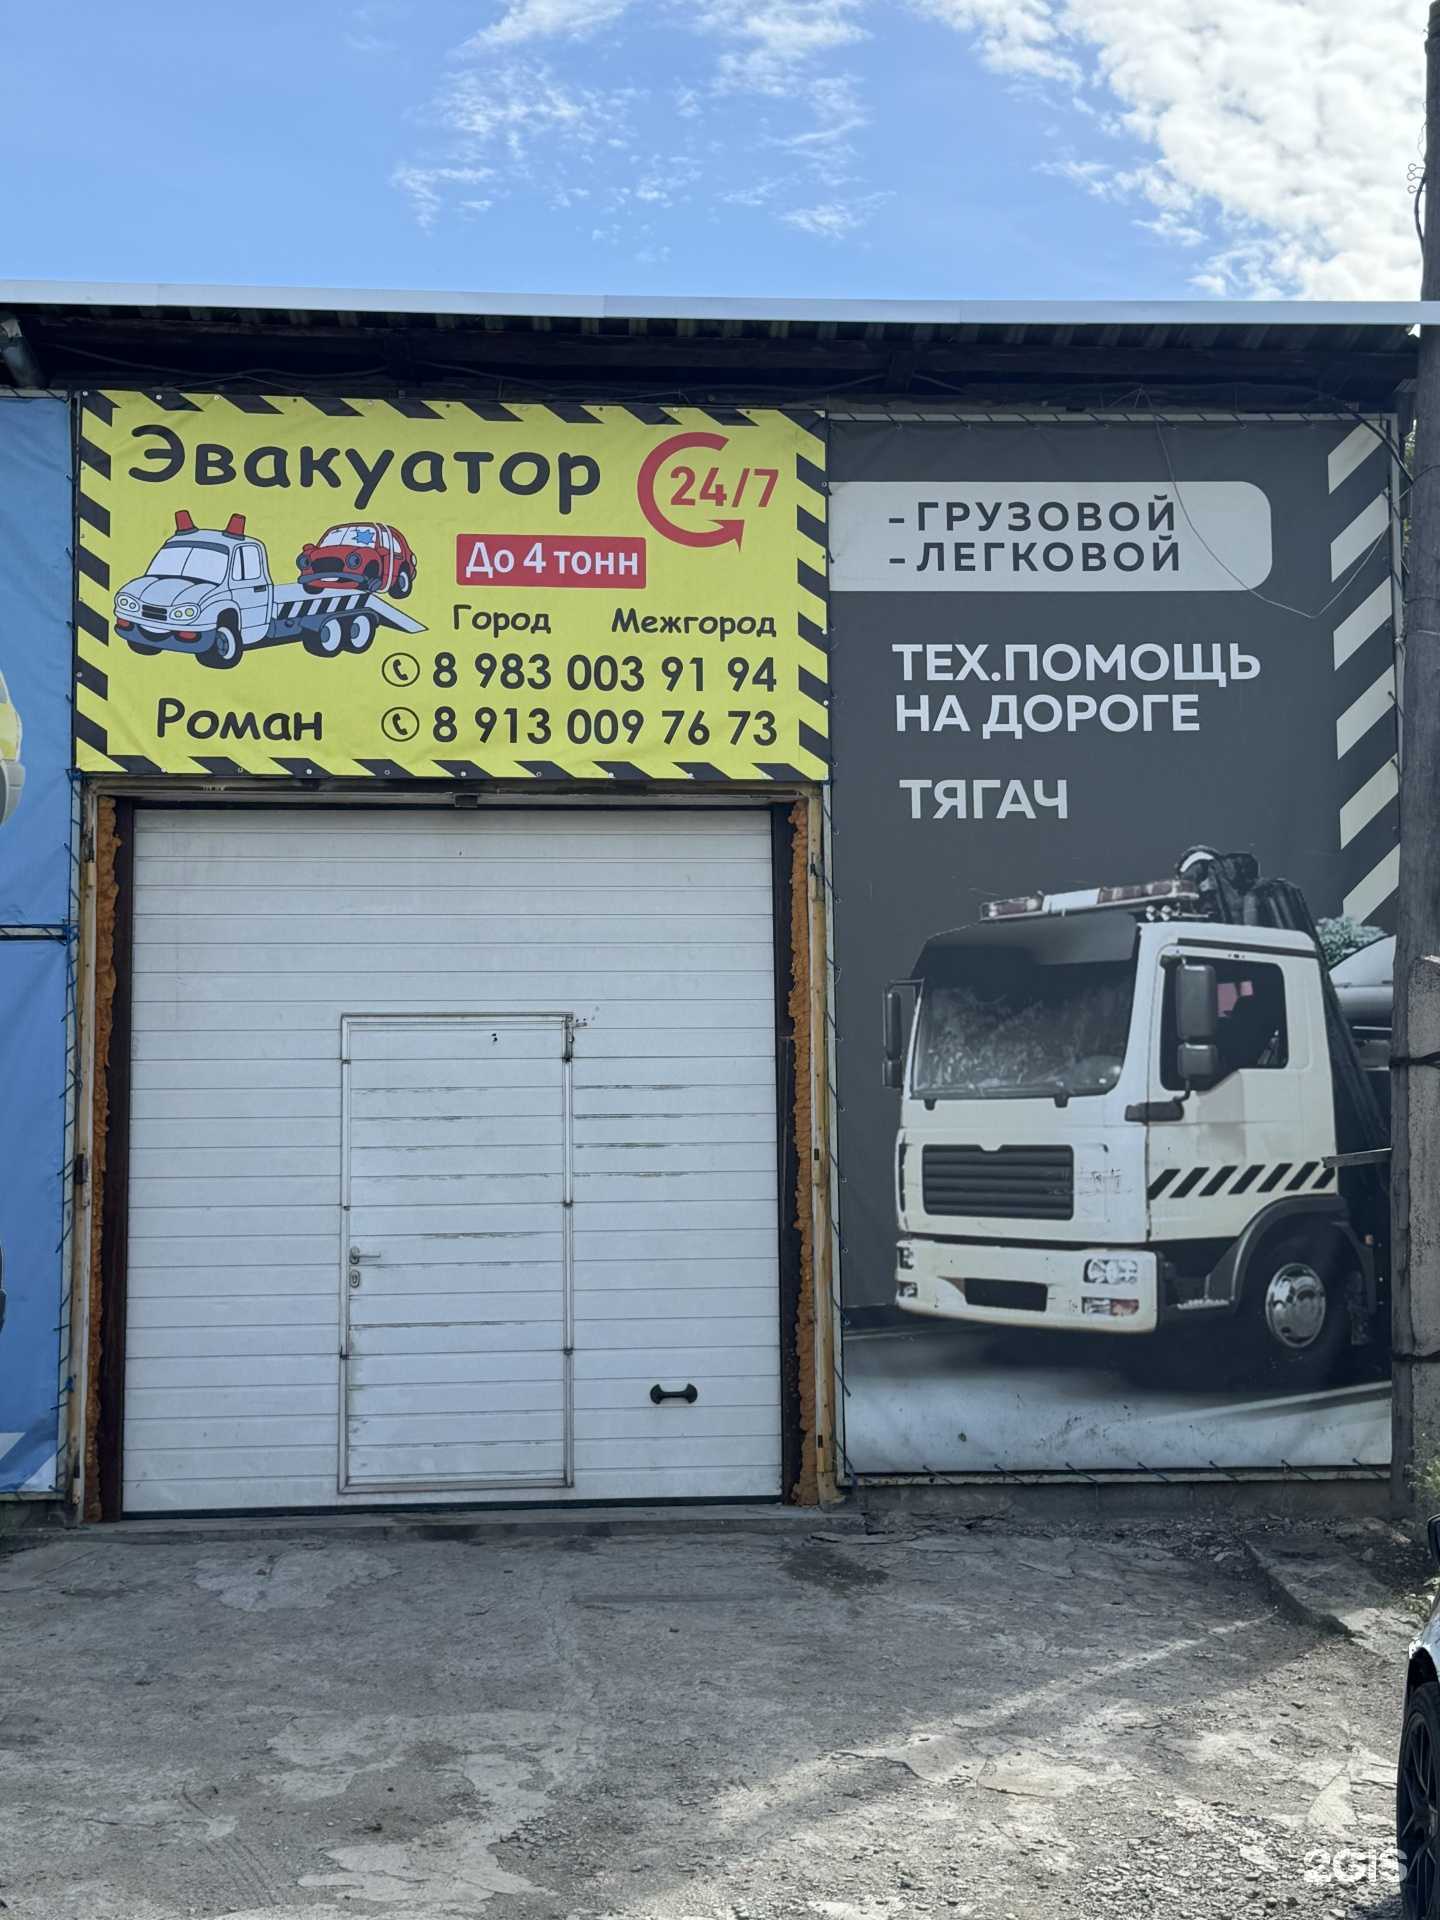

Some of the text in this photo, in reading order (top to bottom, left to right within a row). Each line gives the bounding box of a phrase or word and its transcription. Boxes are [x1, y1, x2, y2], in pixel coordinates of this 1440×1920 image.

[128, 424, 601, 514] Эвакуатор
[669, 466, 779, 508] 24/7
[465, 542, 638, 579] До 4 тонн
[453, 604, 552, 638] Город
[611, 608, 777, 642] Межгород
[432, 652, 777, 693] 8 983 003 91 94
[892, 642, 1261, 688] ТЕХ.ПОМОЩЬ
[157, 697, 322, 741] Роман
[432, 706, 777, 746] 8 913 009 76 73
[896, 694, 1200, 740] НА ДОРОГЕ
[899, 779, 1069, 819] ТЯГАЧ
